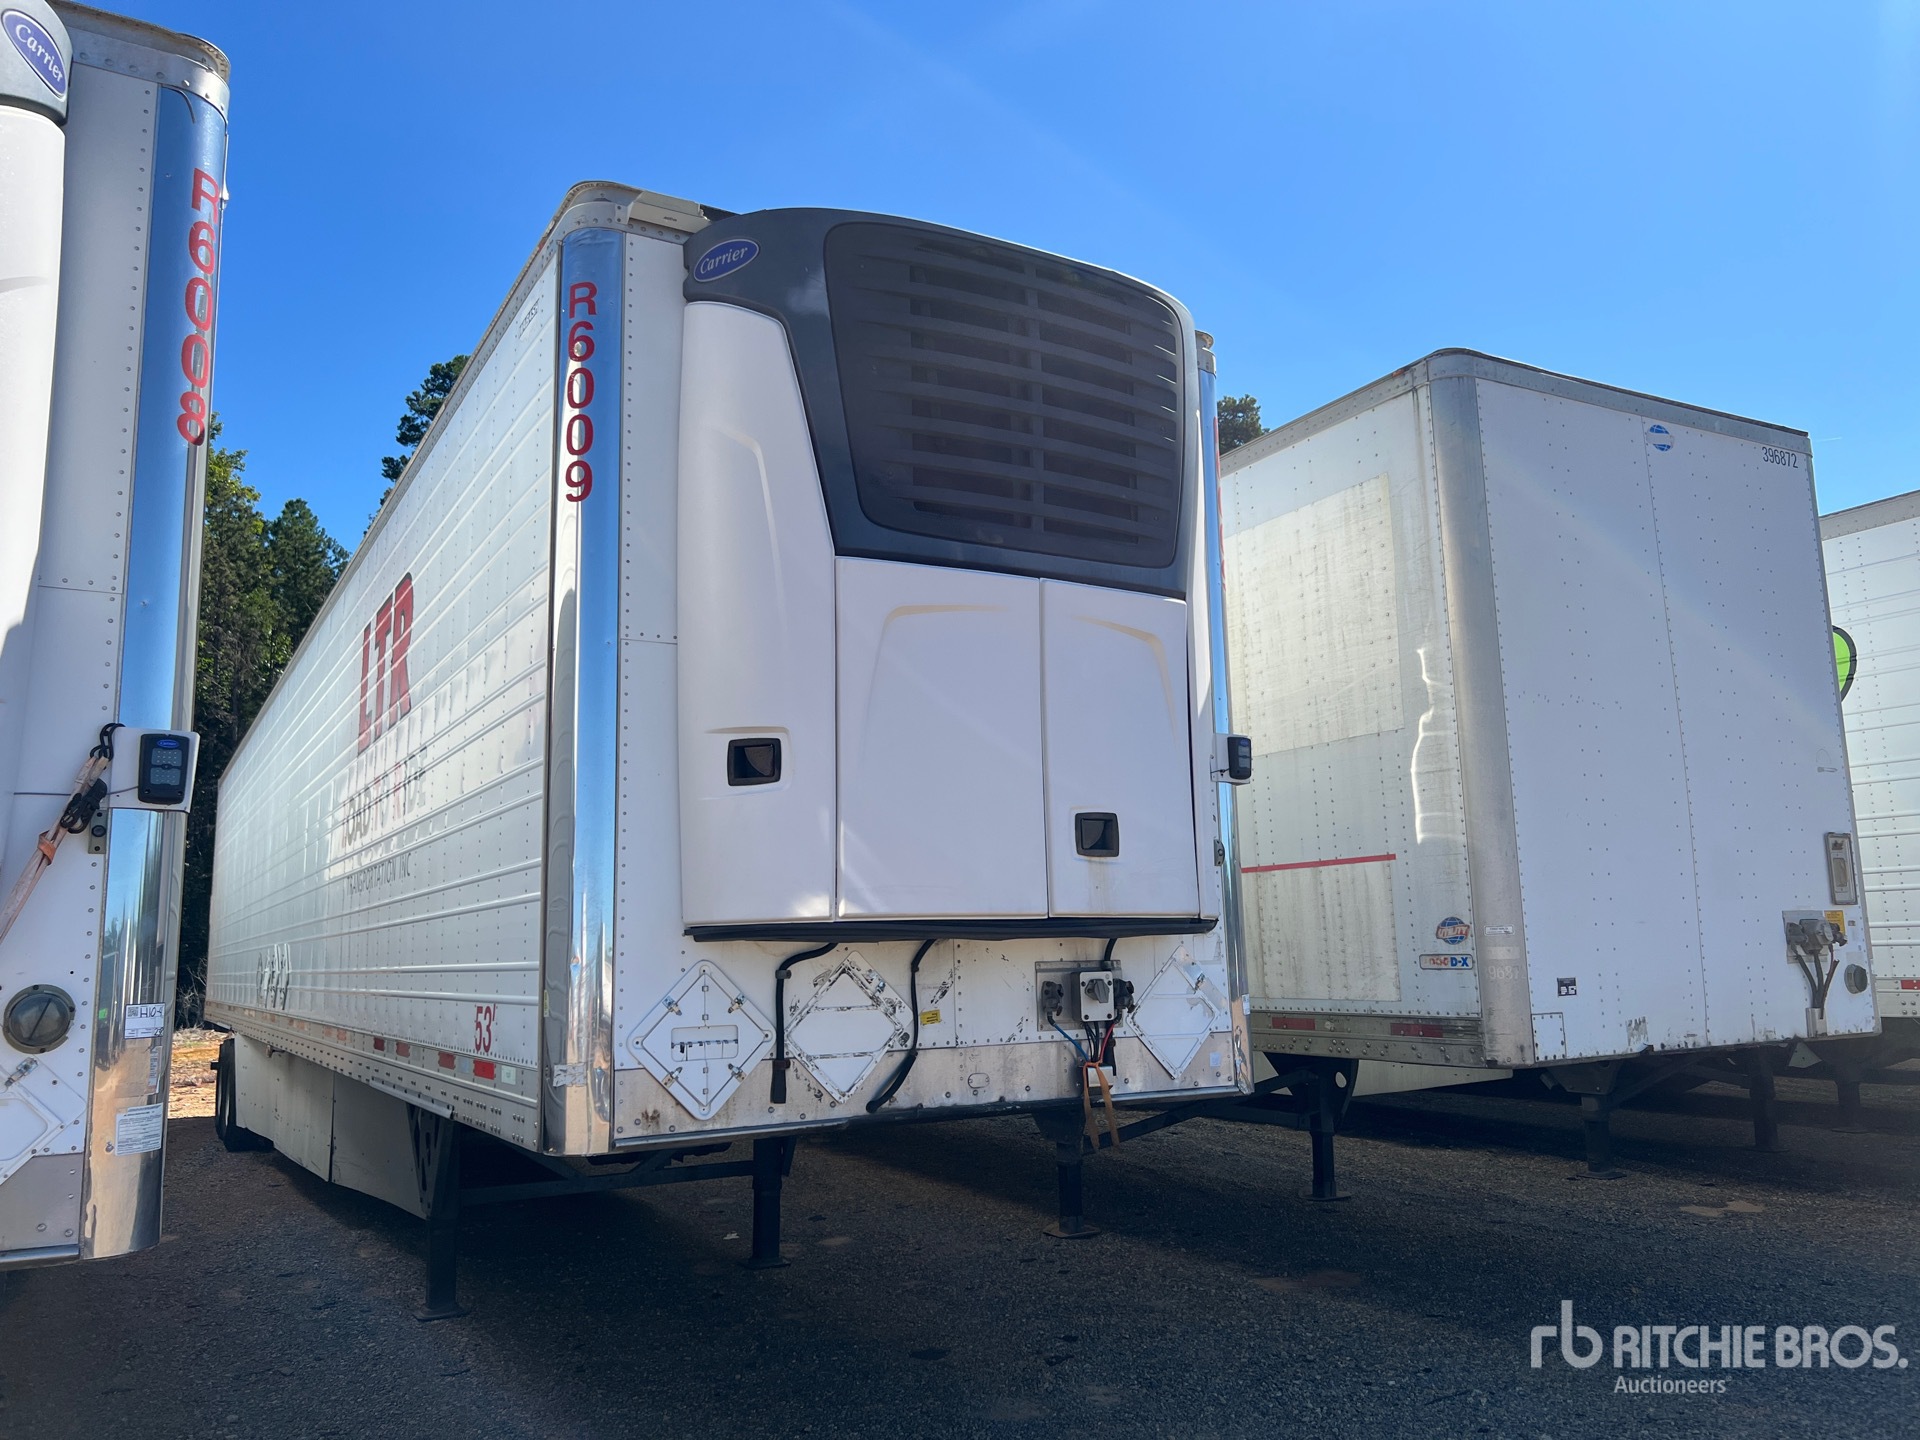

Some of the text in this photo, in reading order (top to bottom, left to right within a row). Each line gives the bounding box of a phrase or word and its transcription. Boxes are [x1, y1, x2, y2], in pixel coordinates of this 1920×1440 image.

[15, 24, 63, 82] Carrier
[700, 247, 748, 274] Carrier
[177, 167, 220, 447] R6008
[565, 281, 598, 502] R6009
[1762, 446, 1799, 469] 396872
[357, 571, 414, 757] LTR
[1438, 925, 1469, 938] UTILITY
